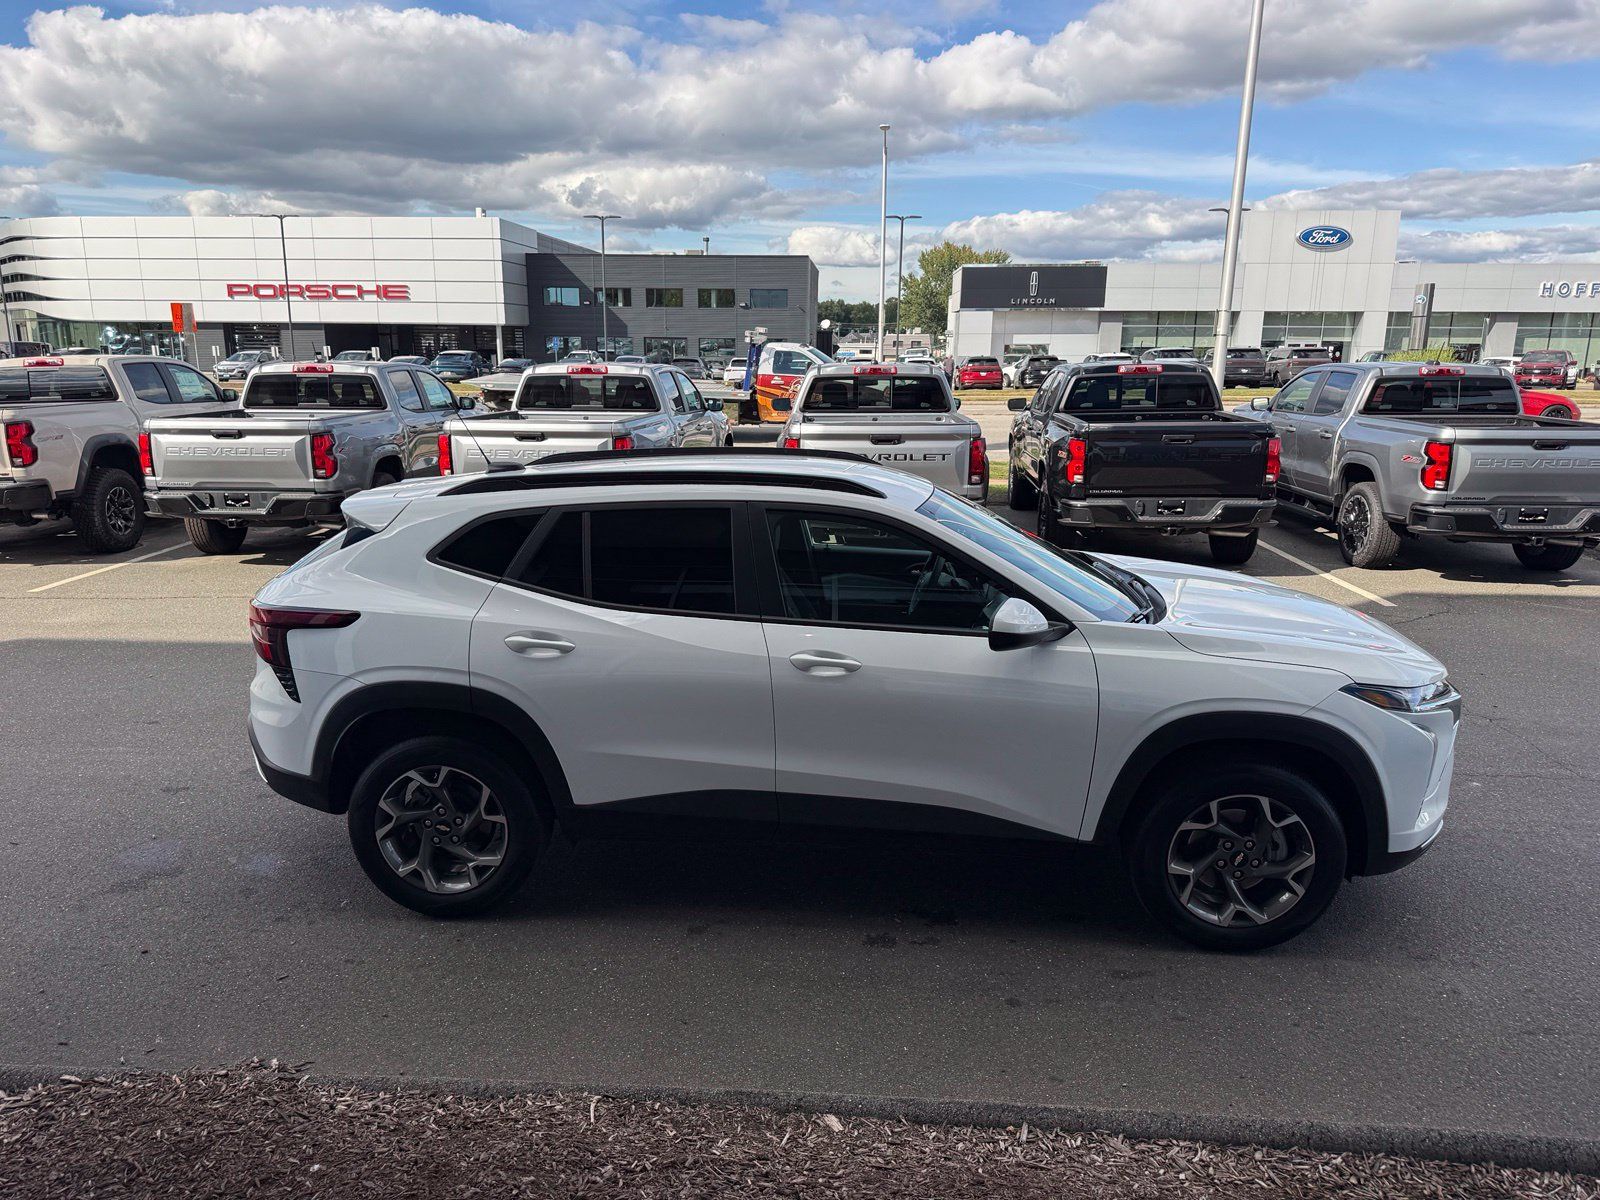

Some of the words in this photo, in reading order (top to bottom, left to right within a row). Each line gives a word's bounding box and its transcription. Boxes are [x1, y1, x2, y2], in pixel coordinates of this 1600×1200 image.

[1309, 230, 1341, 244] Ford
[227, 284, 411, 300] PORSCHE
[1540, 281, 1600, 298] HOFF
[166, 446, 292, 457] CHEVROLET
[466, 449, 560, 459] CHEVRO
[861, 453, 952, 462] VROLET
